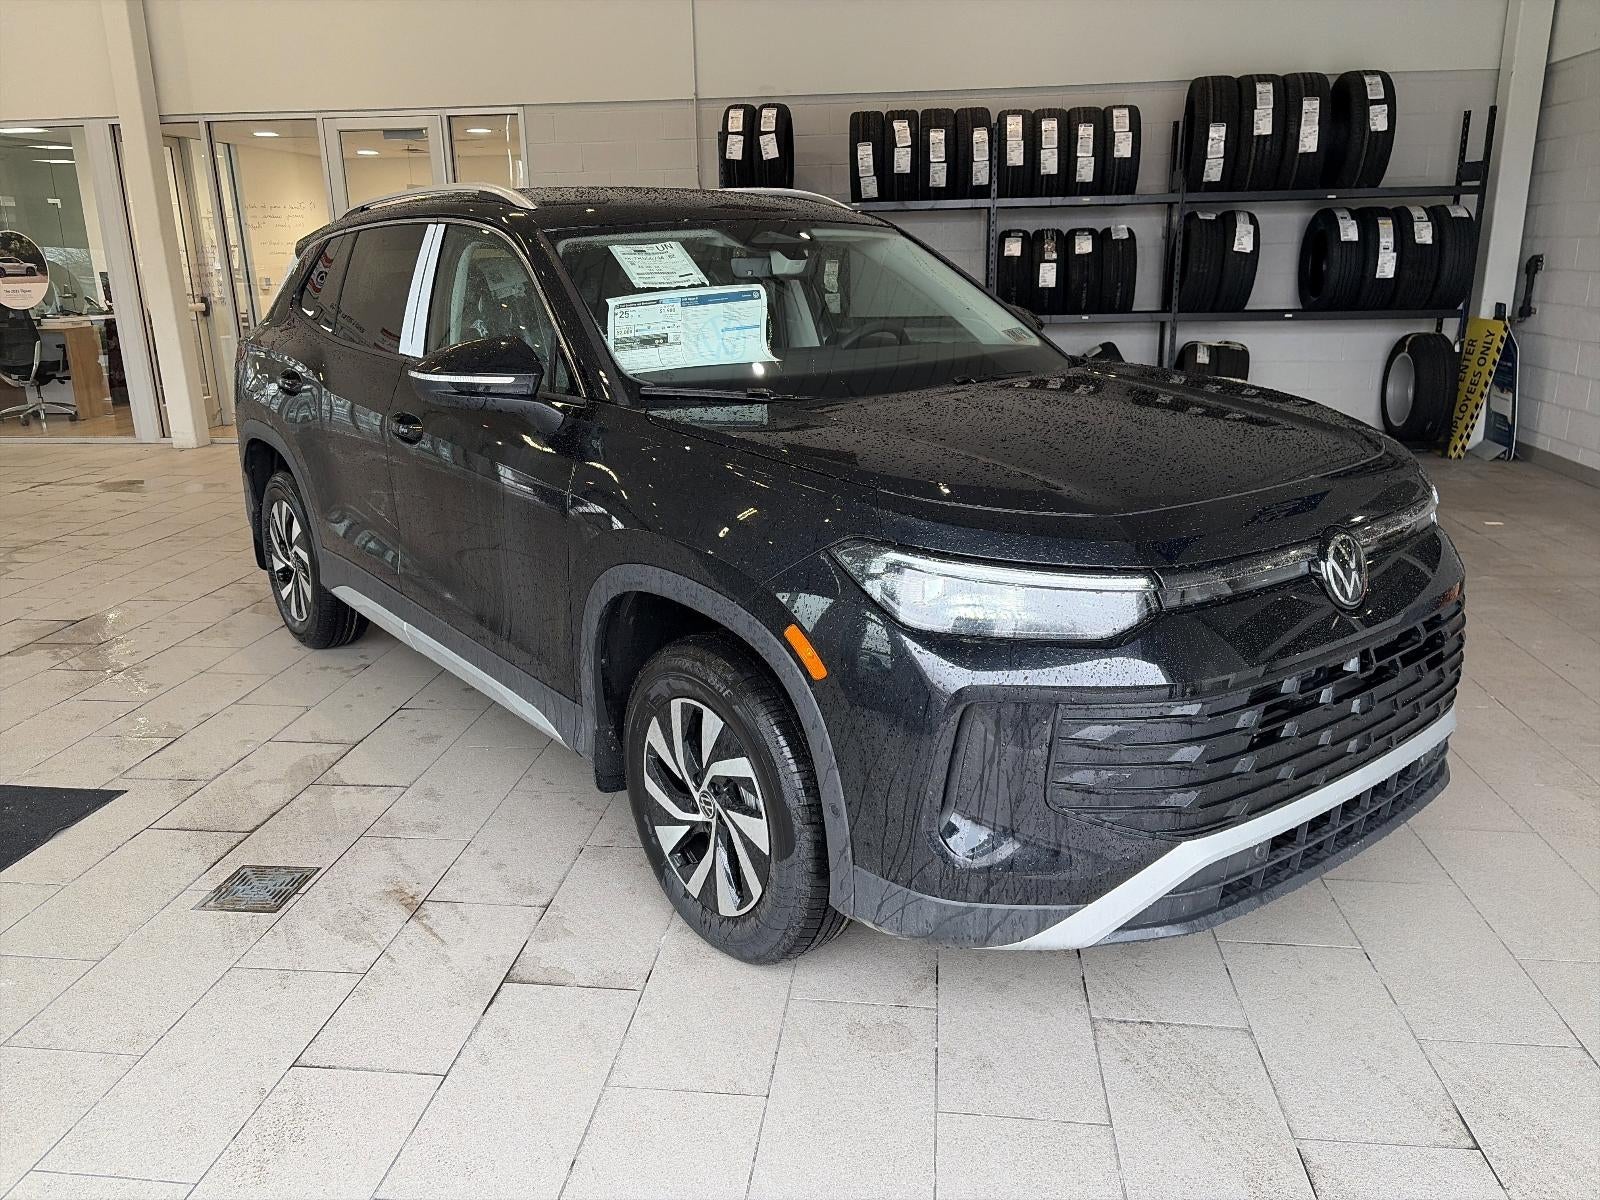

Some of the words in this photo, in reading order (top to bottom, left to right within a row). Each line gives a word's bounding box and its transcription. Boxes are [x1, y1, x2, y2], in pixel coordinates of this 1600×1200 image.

[619, 310, 630, 319] 25
[1459, 338, 1477, 383] ENTER
[1476, 328, 1496, 367] ONLY
